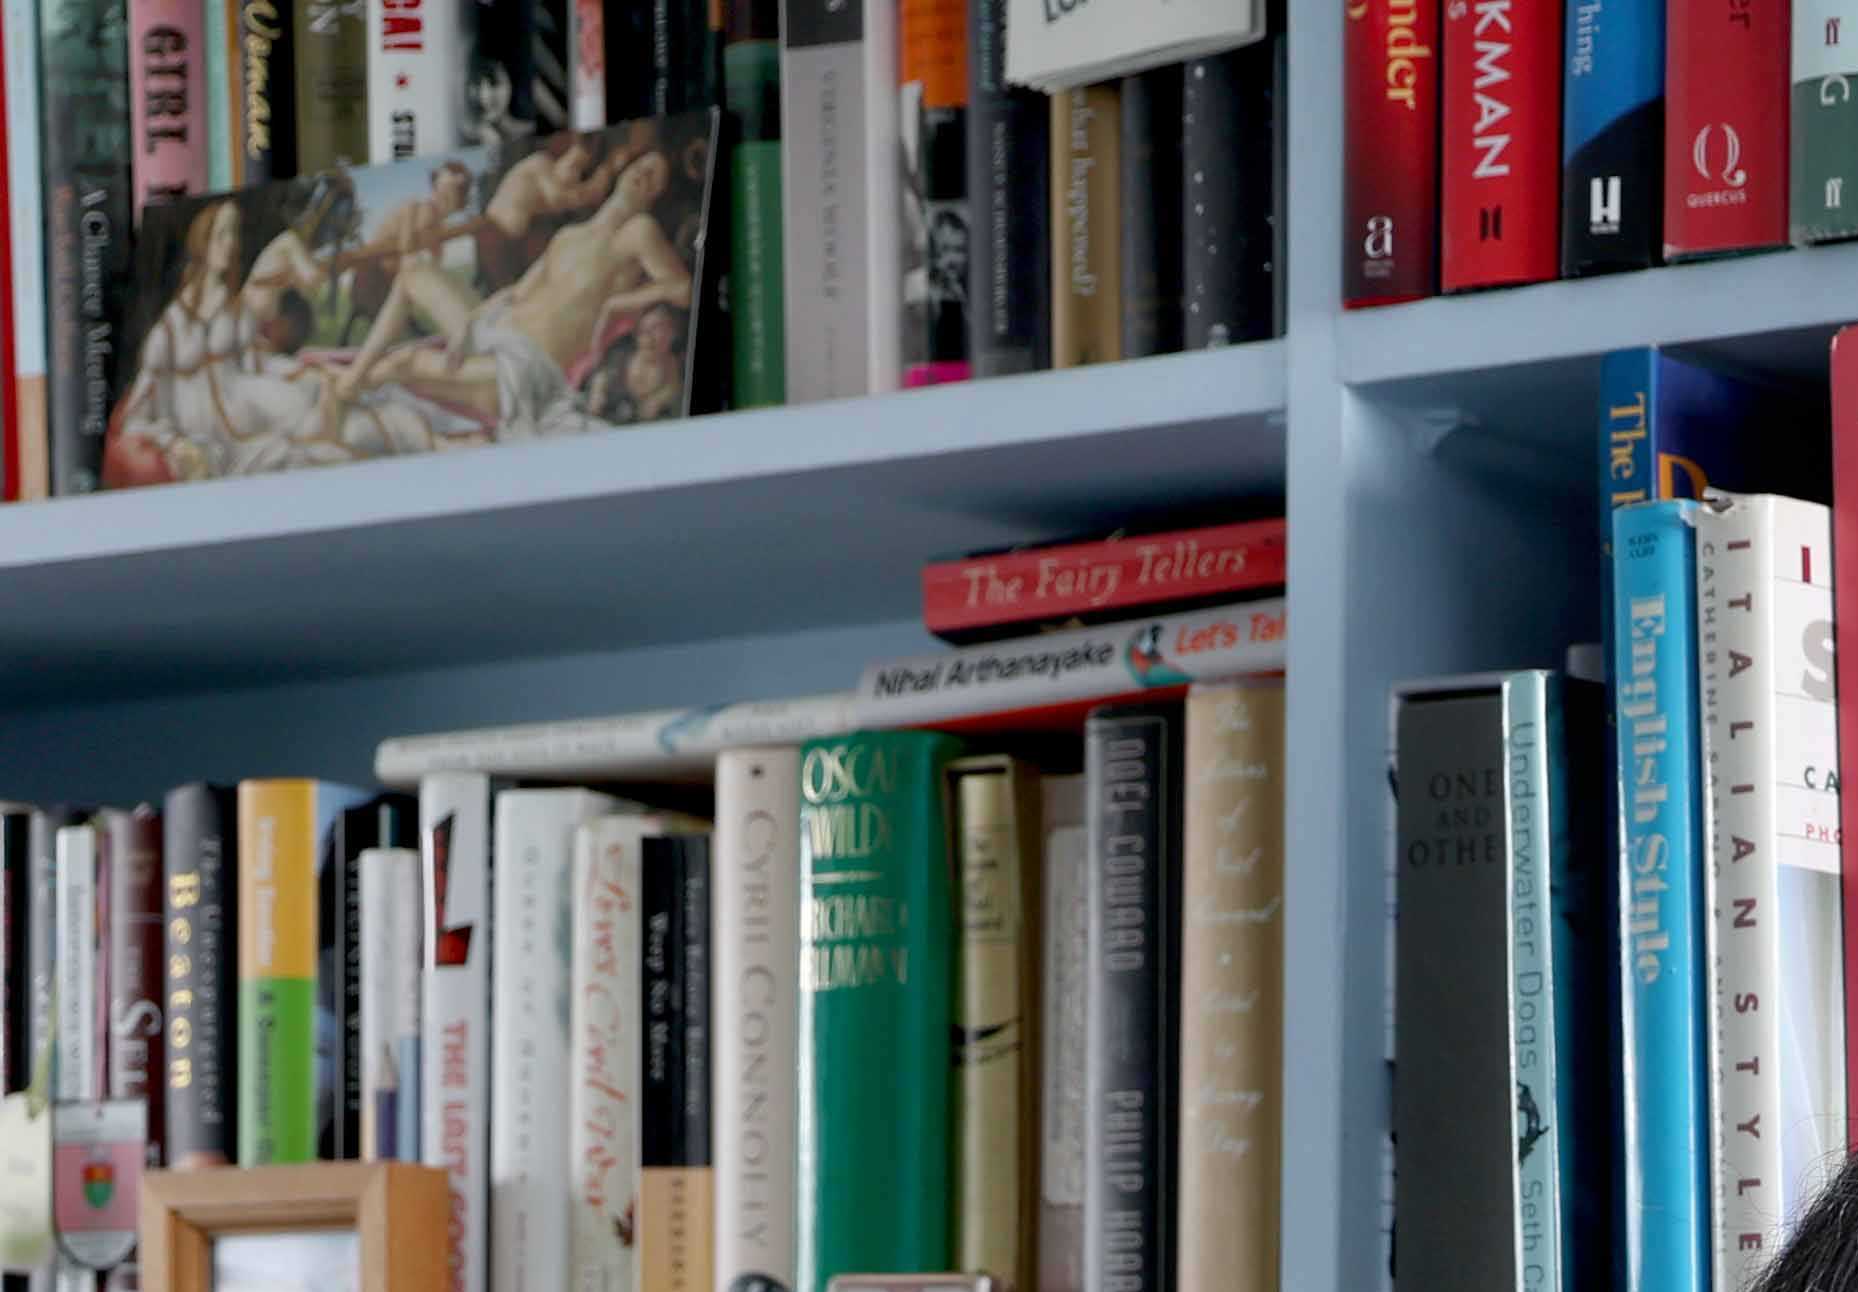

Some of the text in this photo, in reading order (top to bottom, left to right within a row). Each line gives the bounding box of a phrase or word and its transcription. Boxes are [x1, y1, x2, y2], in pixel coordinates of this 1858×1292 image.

[1687, 191, 1747, 208] QUERCUS
[962, 542, 1246, 609] The Fairy Tellers
[1105, 738, 1145, 973] NOEL COWARD
[1508, 720, 1543, 1070] Underwater Dogs
[1104, 1090, 1143, 1192] PHILIP
[1519, 1180, 1543, 1255] Seth
